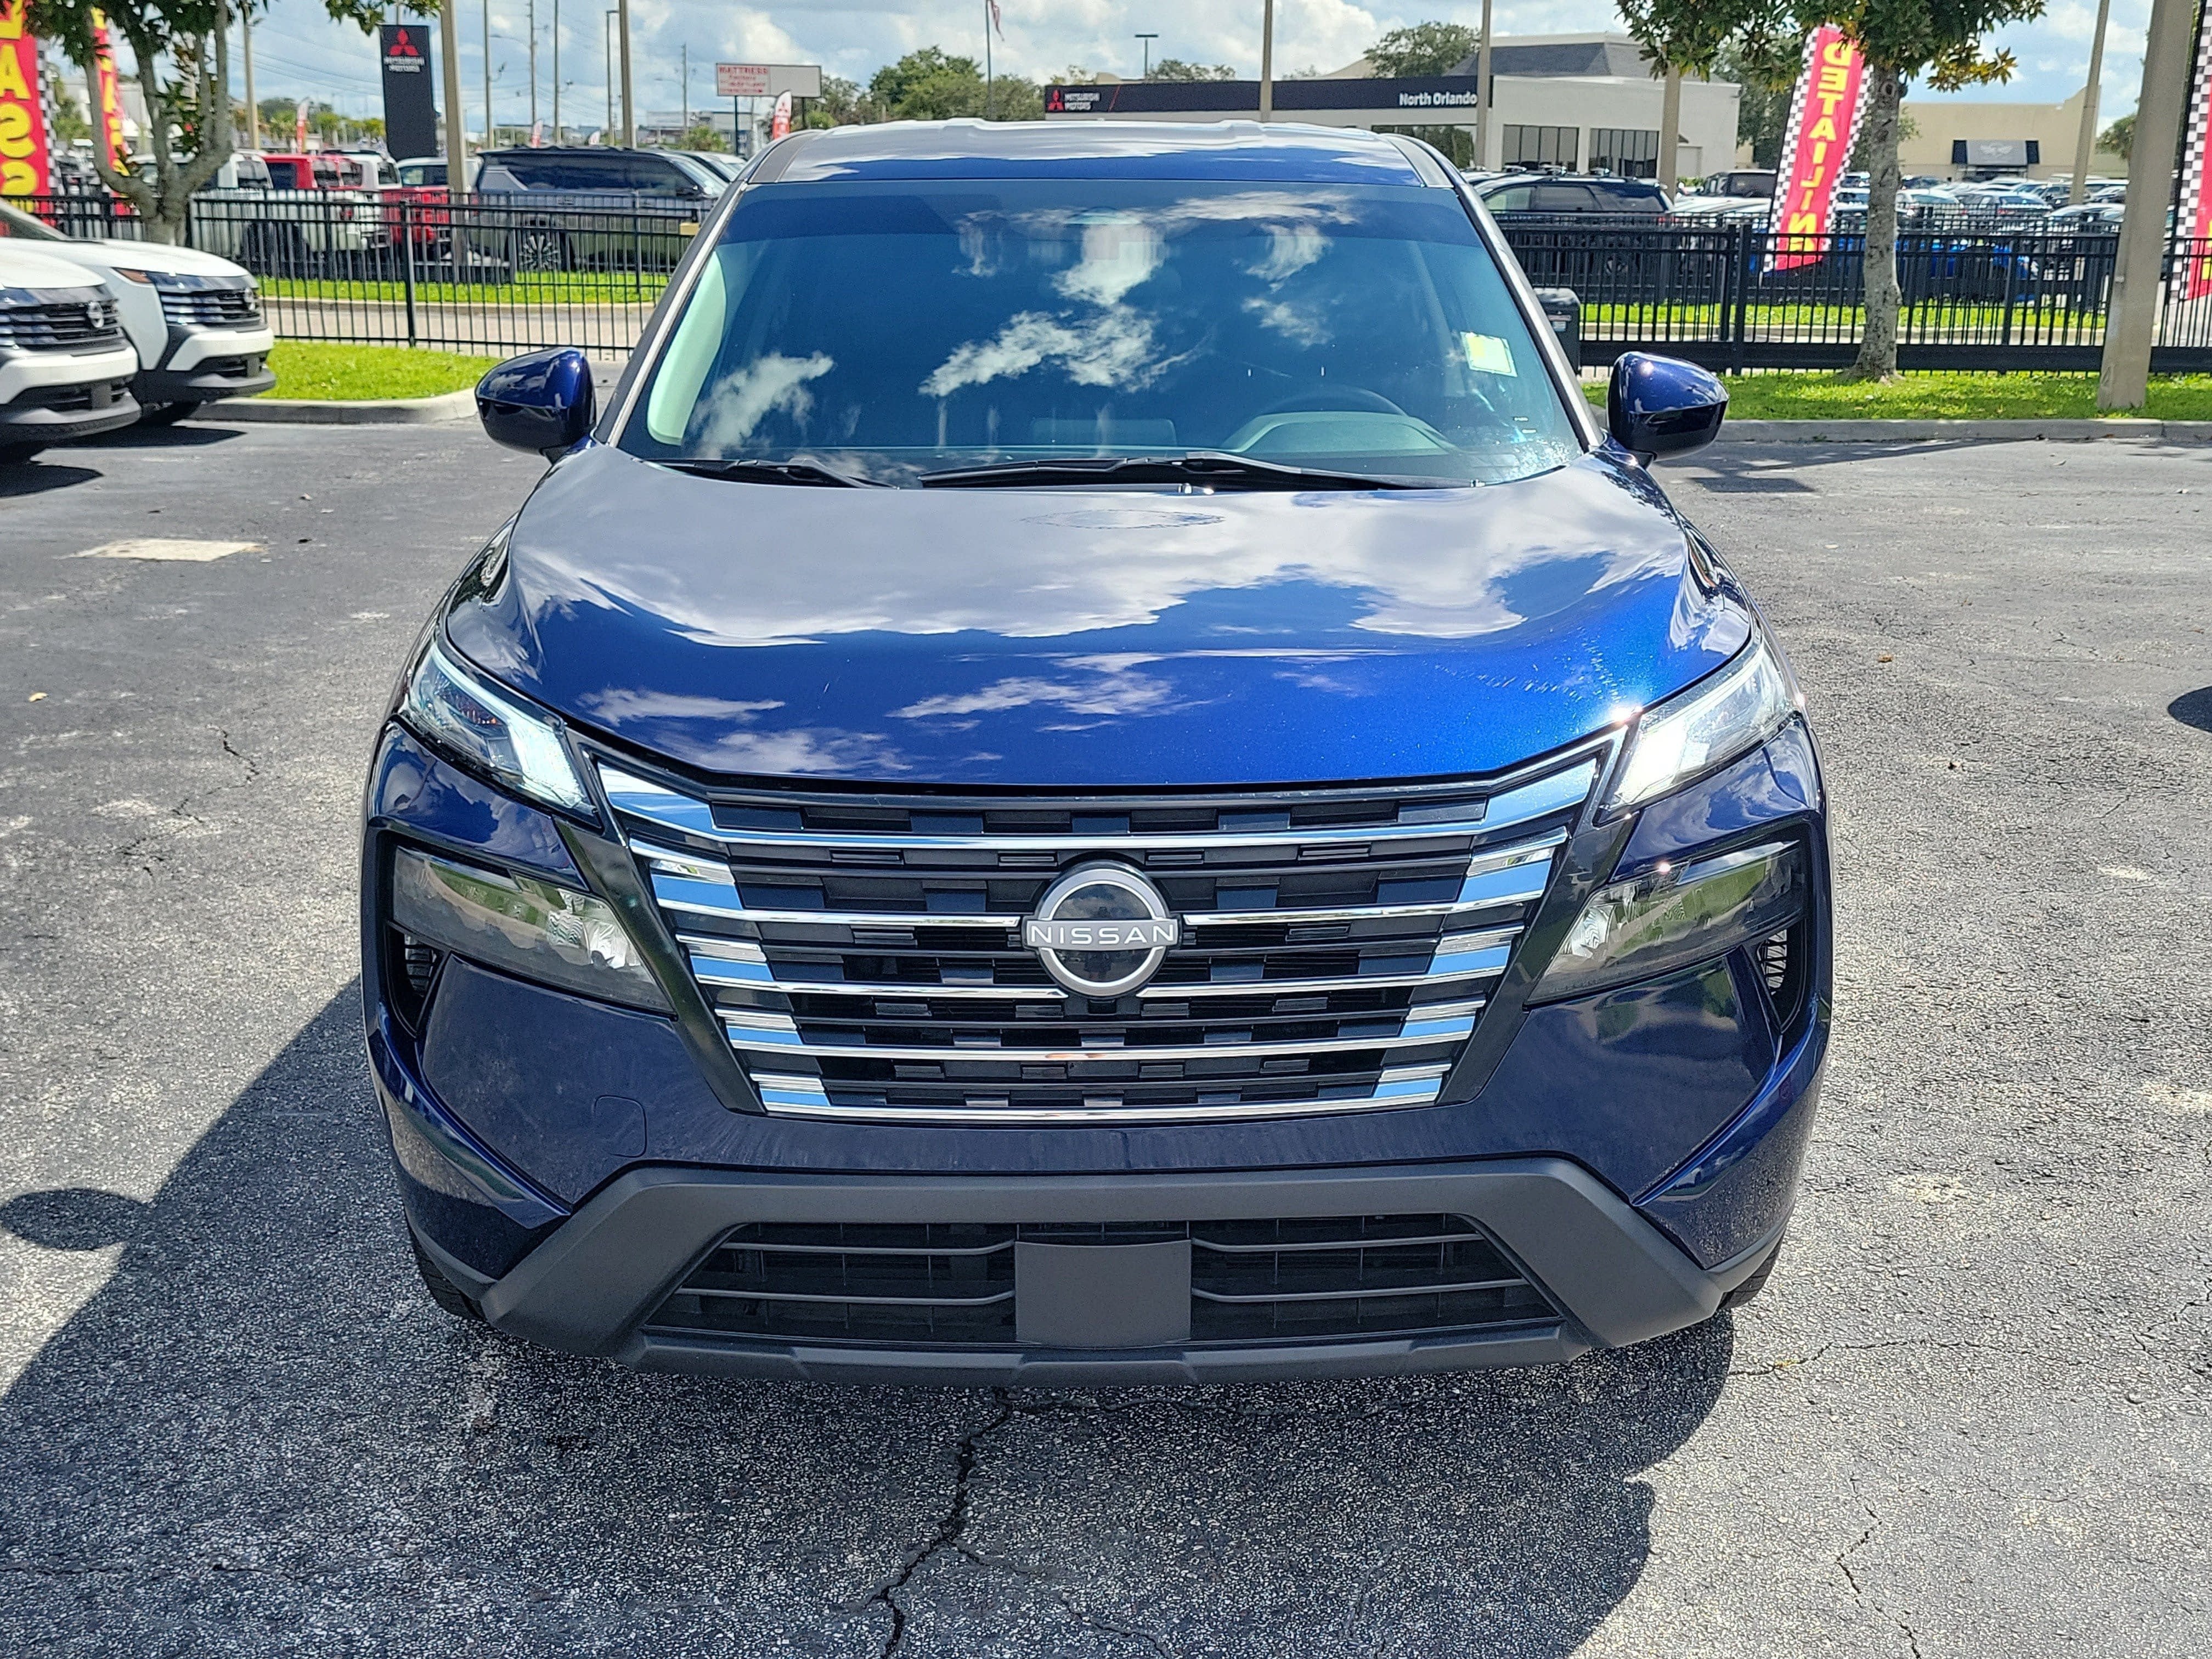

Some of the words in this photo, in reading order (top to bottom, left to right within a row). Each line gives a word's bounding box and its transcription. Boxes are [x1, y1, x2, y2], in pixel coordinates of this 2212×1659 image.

[1400, 92, 1432, 106] North
[1432, 91, 1478, 105] Orlando
[1030, 924, 1175, 945] NISSAN
